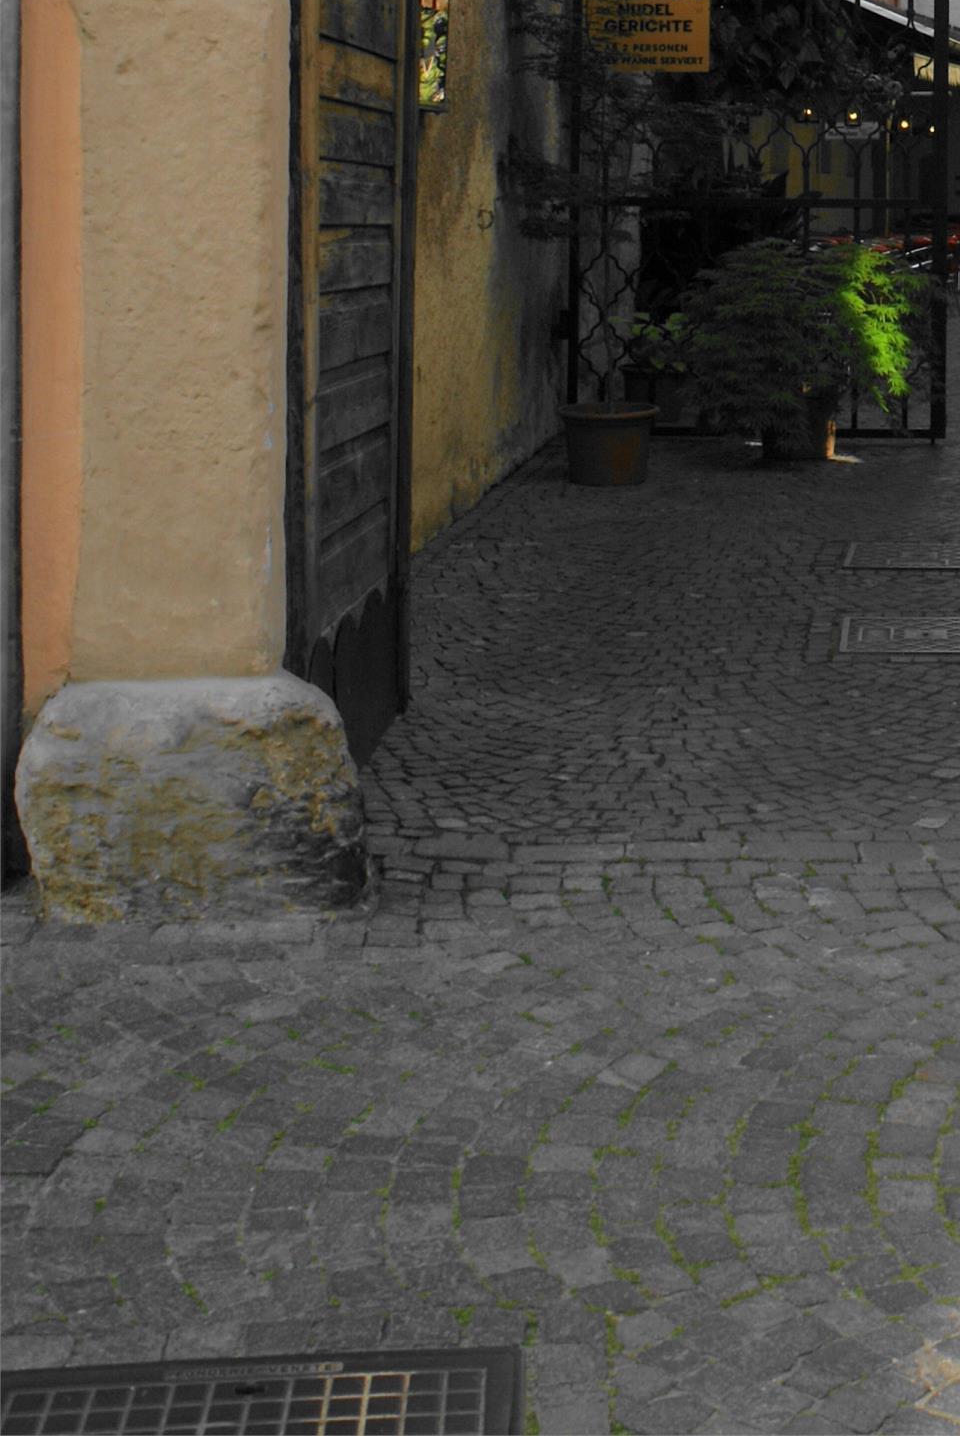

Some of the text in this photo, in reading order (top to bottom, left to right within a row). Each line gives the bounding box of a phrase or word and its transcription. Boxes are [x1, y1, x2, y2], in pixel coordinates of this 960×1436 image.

[618, 3, 674, 16] NUDEL
[604, 19, 693, 33] GERICHTE
[633, 43, 688, 52] PERSONEN
[660, 56, 703, 65] SERVIERT
